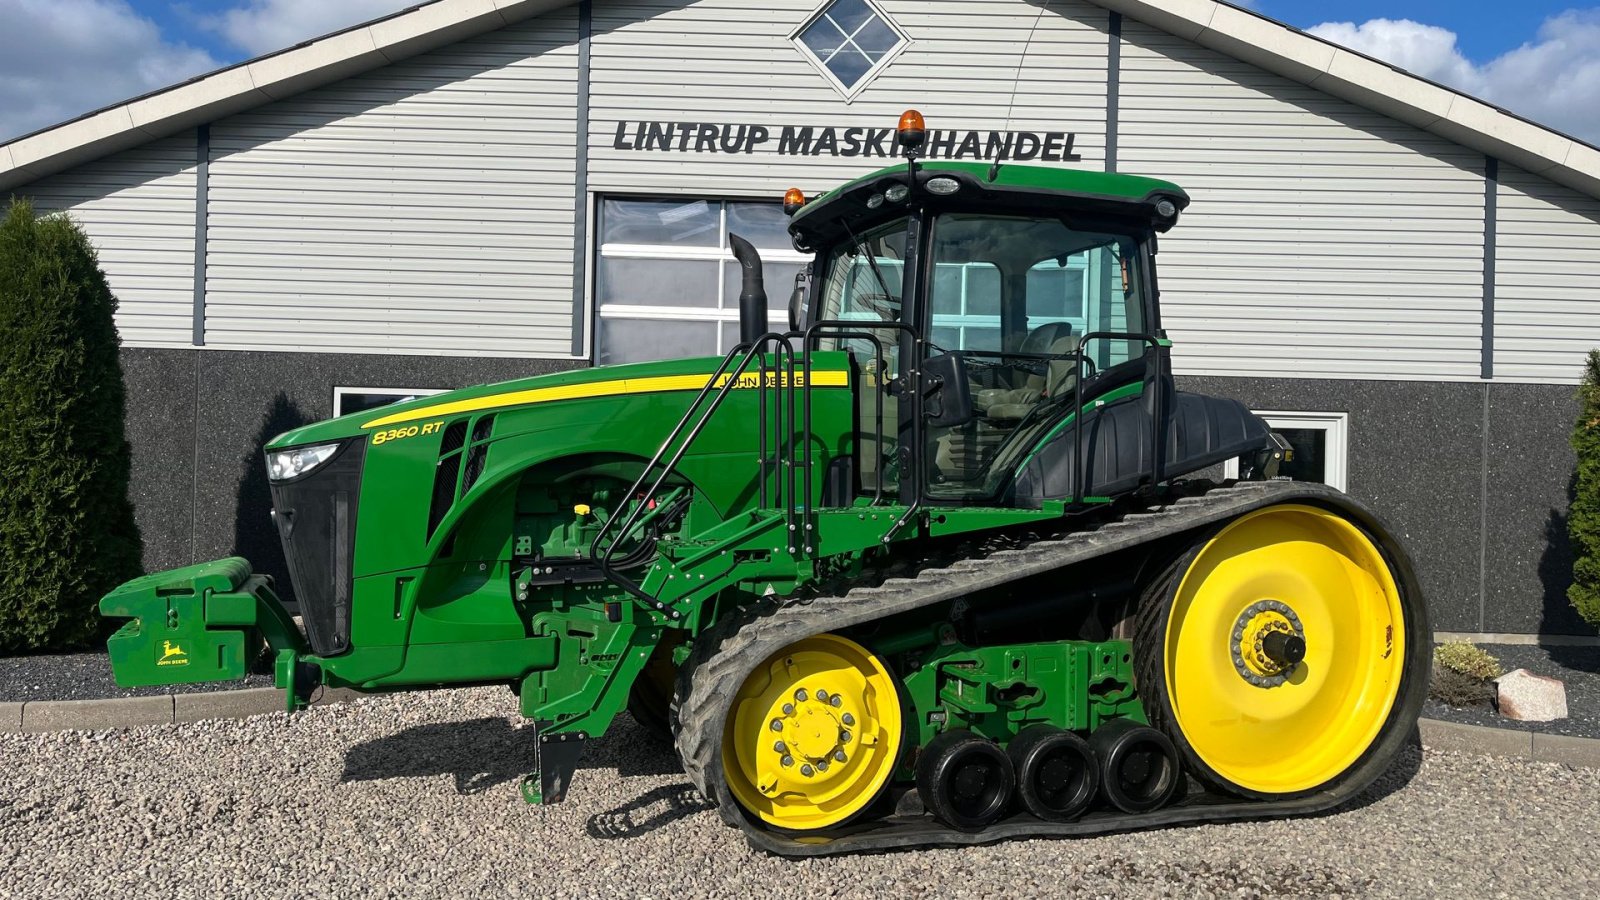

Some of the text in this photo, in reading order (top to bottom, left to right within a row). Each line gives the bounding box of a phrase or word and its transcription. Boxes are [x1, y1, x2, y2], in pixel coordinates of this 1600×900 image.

[613, 120, 769, 154] LINTRUP
[372, 421, 445, 445] 8360 RT
